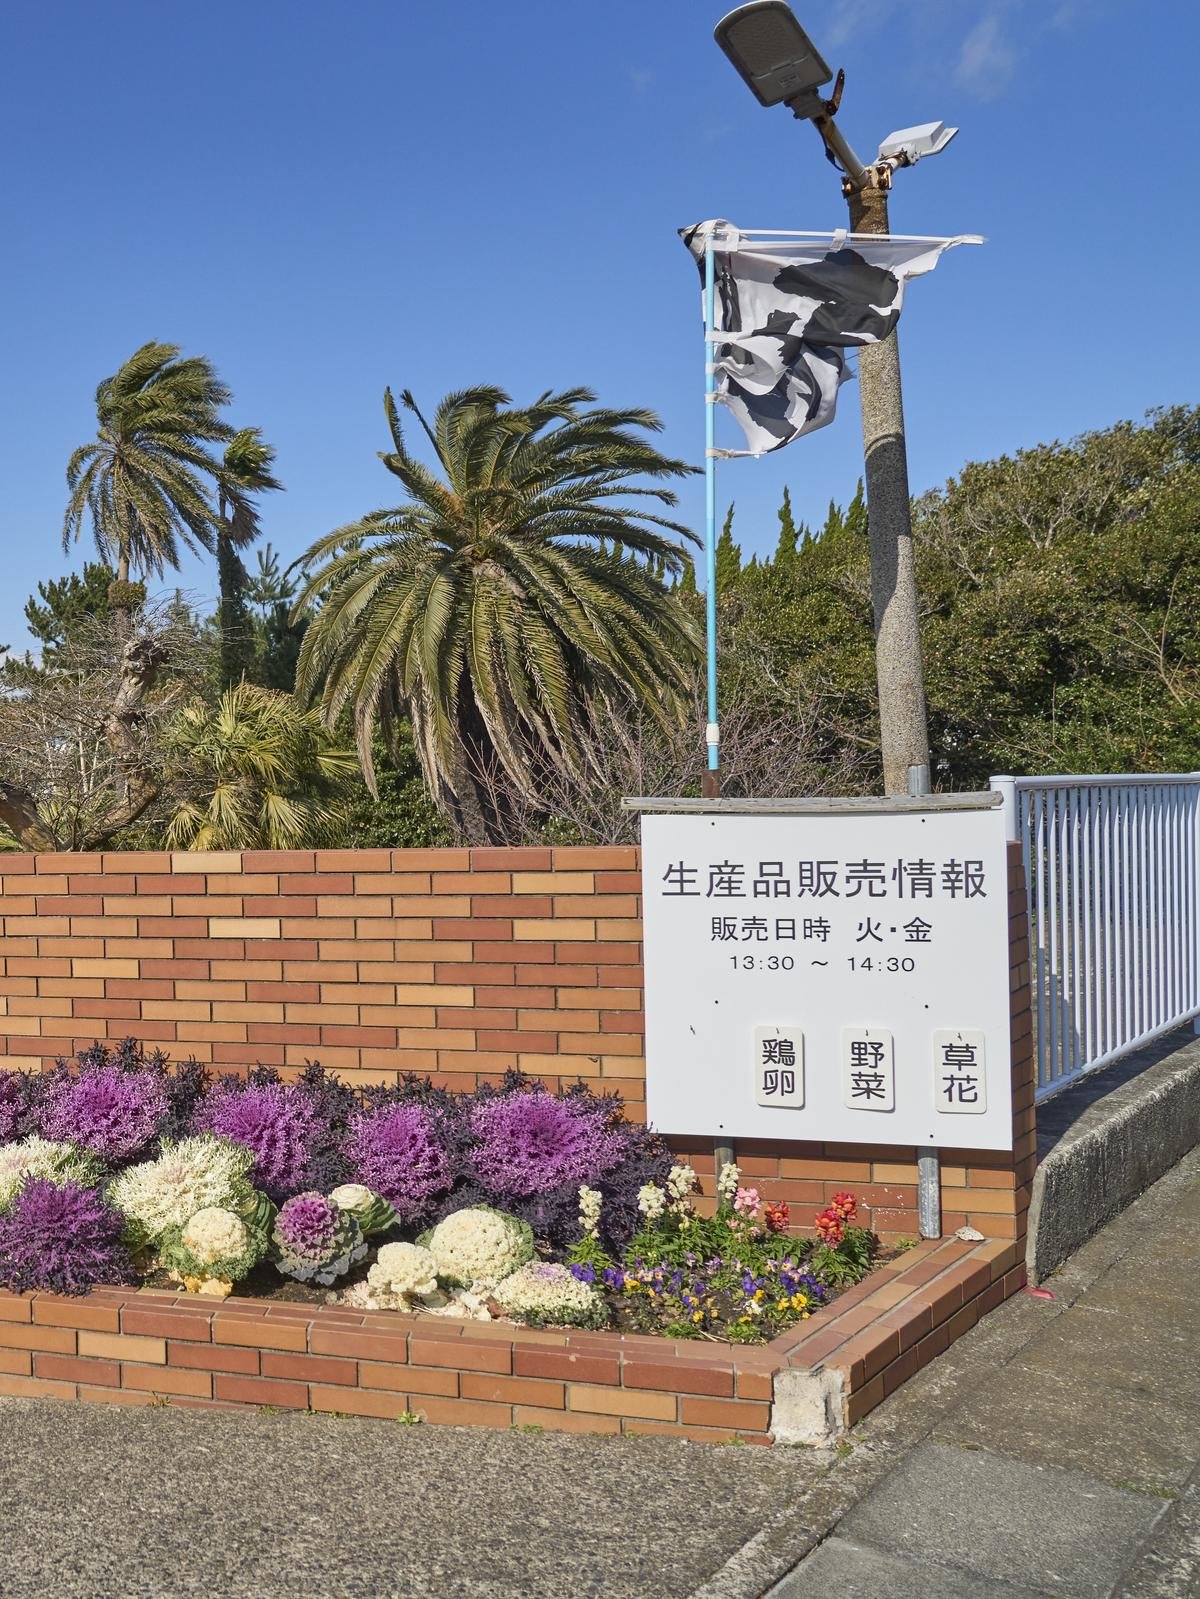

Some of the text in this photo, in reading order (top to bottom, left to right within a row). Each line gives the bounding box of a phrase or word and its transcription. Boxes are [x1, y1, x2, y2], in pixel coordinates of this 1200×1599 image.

[662, 858, 988, 899] 生産品販売情報
[711, 916, 933, 943] 販売日時 火・金
[730, 955, 795, 971] 13:30
[847, 957, 916, 973] 14:30
[762, 1038, 796, 1097] 鶏卵
[851, 1041, 886, 1099] 野菜
[942, 1043, 979, 1103] 草花
